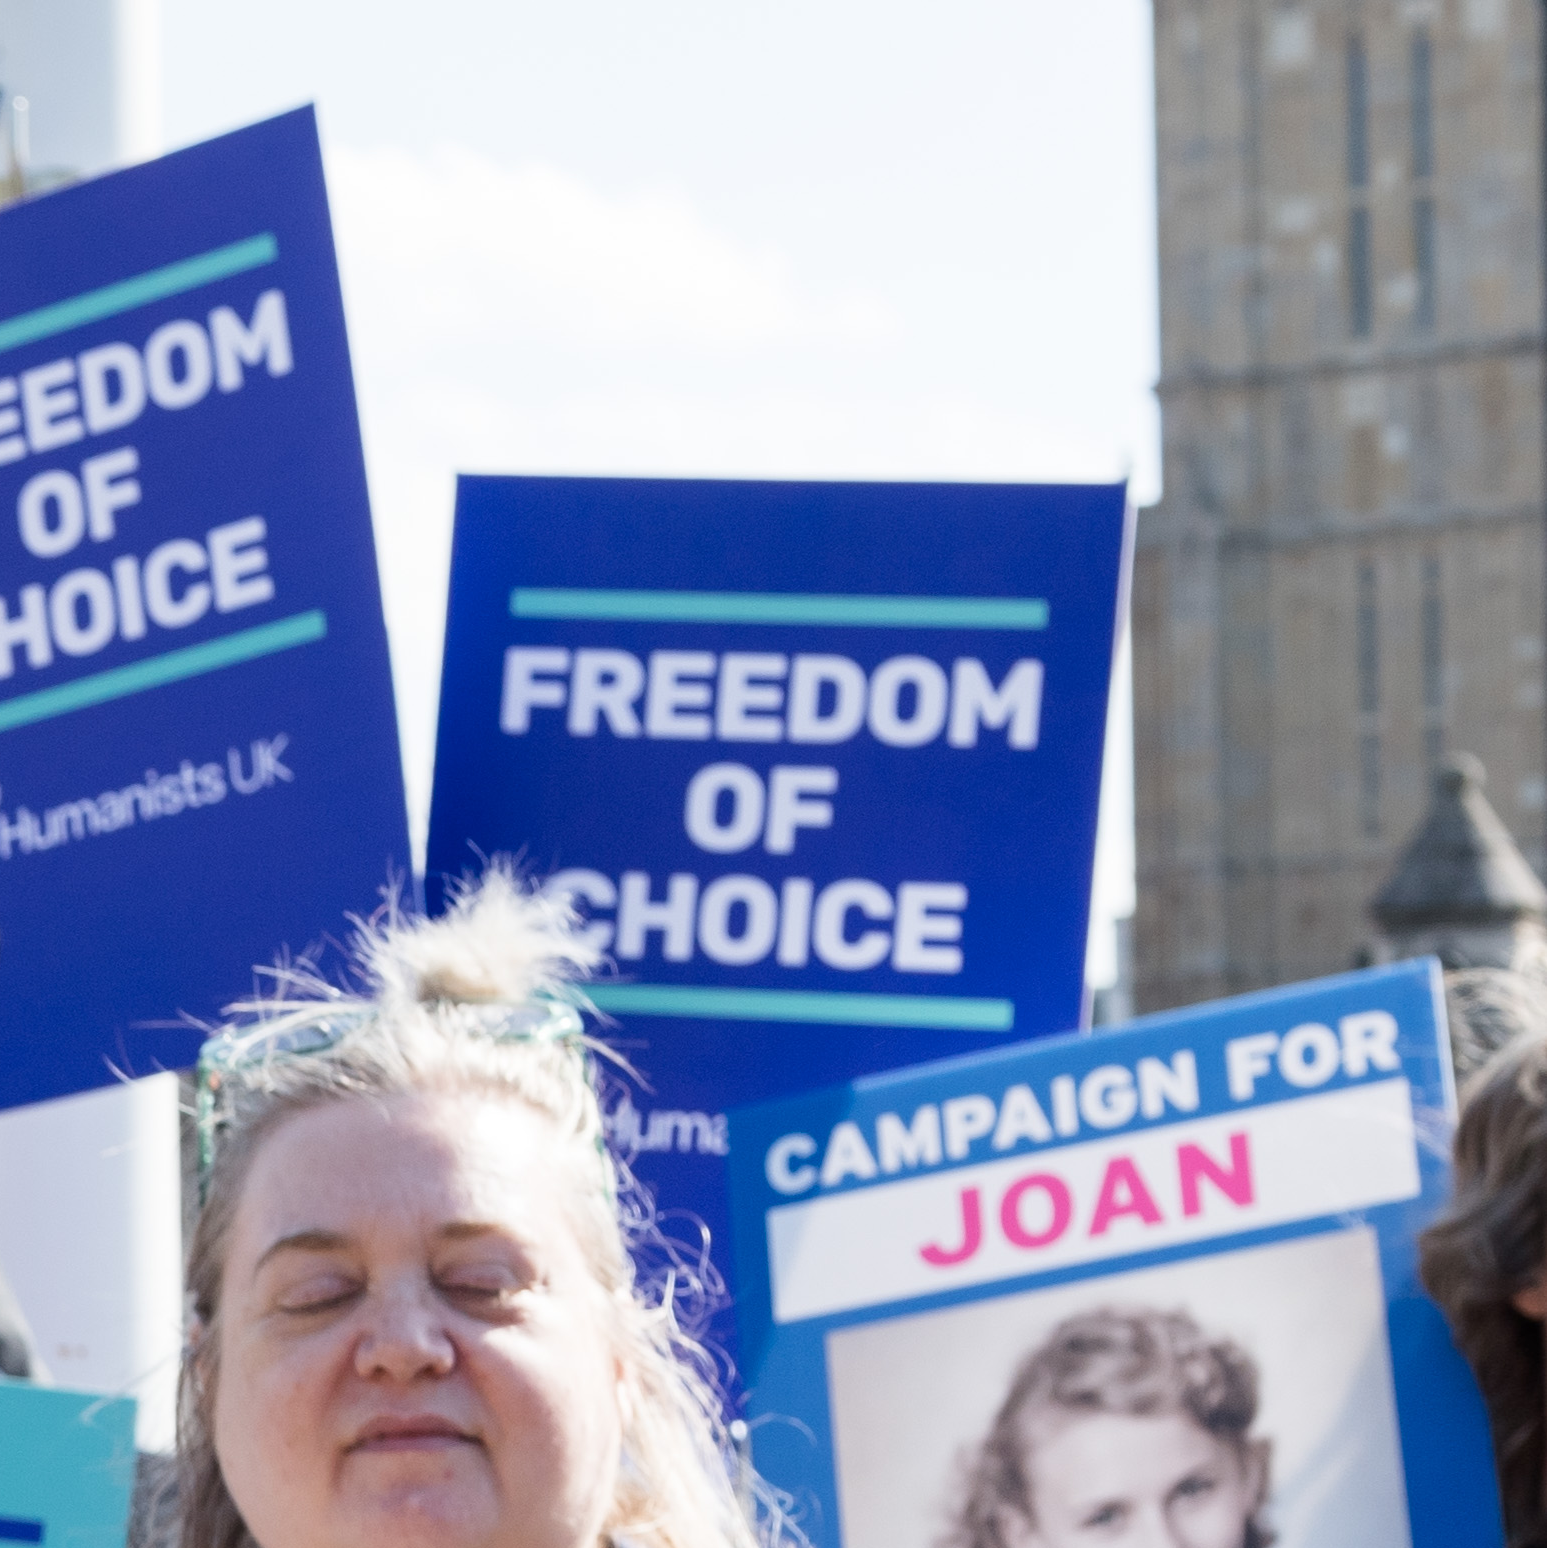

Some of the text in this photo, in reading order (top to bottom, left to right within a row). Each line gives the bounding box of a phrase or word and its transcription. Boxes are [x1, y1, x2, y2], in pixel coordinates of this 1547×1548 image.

[16, 447, 142, 559] OF
[500, 646, 1045, 750] FREEDOM
[227, 732, 295, 796] UK
[684, 761, 839, 855] OF
[542, 867, 968, 974] CHOICE
[765, 1010, 1401, 1195] CAMPAIGN FOR
[918, 1130, 1257, 1269] JOAN
